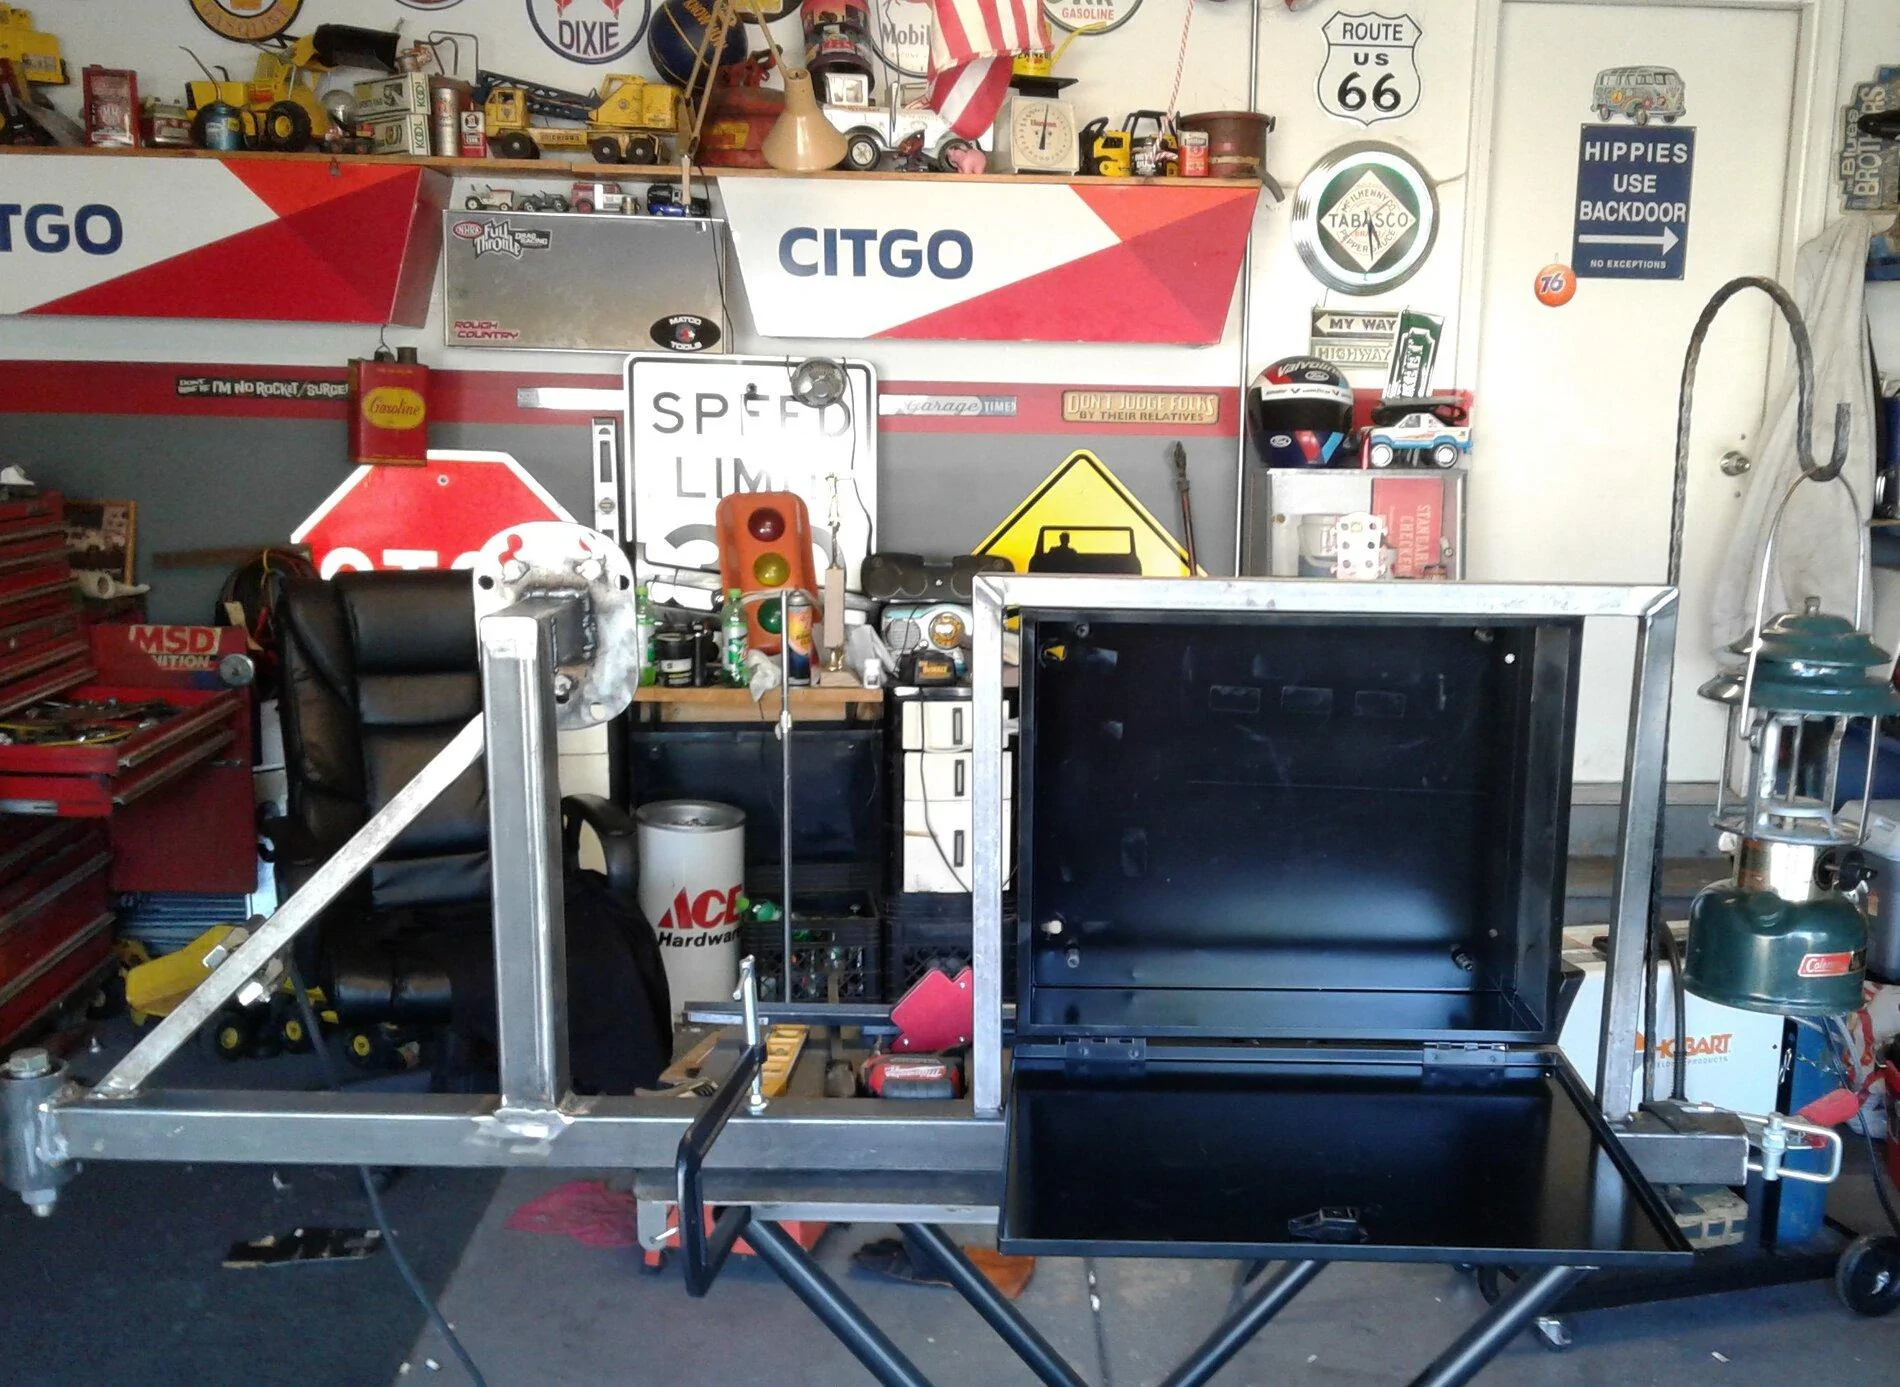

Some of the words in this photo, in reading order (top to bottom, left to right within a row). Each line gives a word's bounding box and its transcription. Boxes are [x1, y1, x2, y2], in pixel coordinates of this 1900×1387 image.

[1061, 7, 1115, 20] GASOLINE
[558, 20, 620, 55] DIXIE
[882, 23, 930, 45] Mobil
[1342, 23, 1404, 41] ROUTE
[414, 81, 427, 107] KOOL
[1337, 71, 1402, 112] 66
[413, 121, 425, 149] KOOL
[1853, 87, 1886, 195] BROTRS
[1584, 141, 1688, 164] HIPPIES
[1613, 173, 1657, 193] USE
[1328, 213, 1409, 228] TABASCO
[1579, 200, 1687, 223] BACKDOOR
[778, 226, 974, 280] CITGO
[1590, 259, 1604, 268] NO
[1607, 259, 1667, 270] EXCEPTIONS
[1540, 271, 1564, 293] 76
[454, 321, 498, 330] ROUGH
[669, 316, 702, 325] MATCO
[1329, 318, 1355, 330] MY
[1362, 319, 1397, 331] WAY
[457, 331, 519, 339] COUNTRY
[671, 341, 702, 350] TOOLS
[1316, 347, 1392, 362] HIGHWAY
[234, 380, 255, 394] NO
[1118, 394, 1167, 411] JUDGE
[1170, 395, 1216, 416] FOLKS
[1079, 410, 1094, 419] BY
[1100, 411, 1136, 420] THEIR
[1140, 411, 1204, 422] RELATIVES
[133, 626, 216, 654] MSD
[658, 884, 743, 929] ACE
[659, 929, 741, 948] Hardwar
